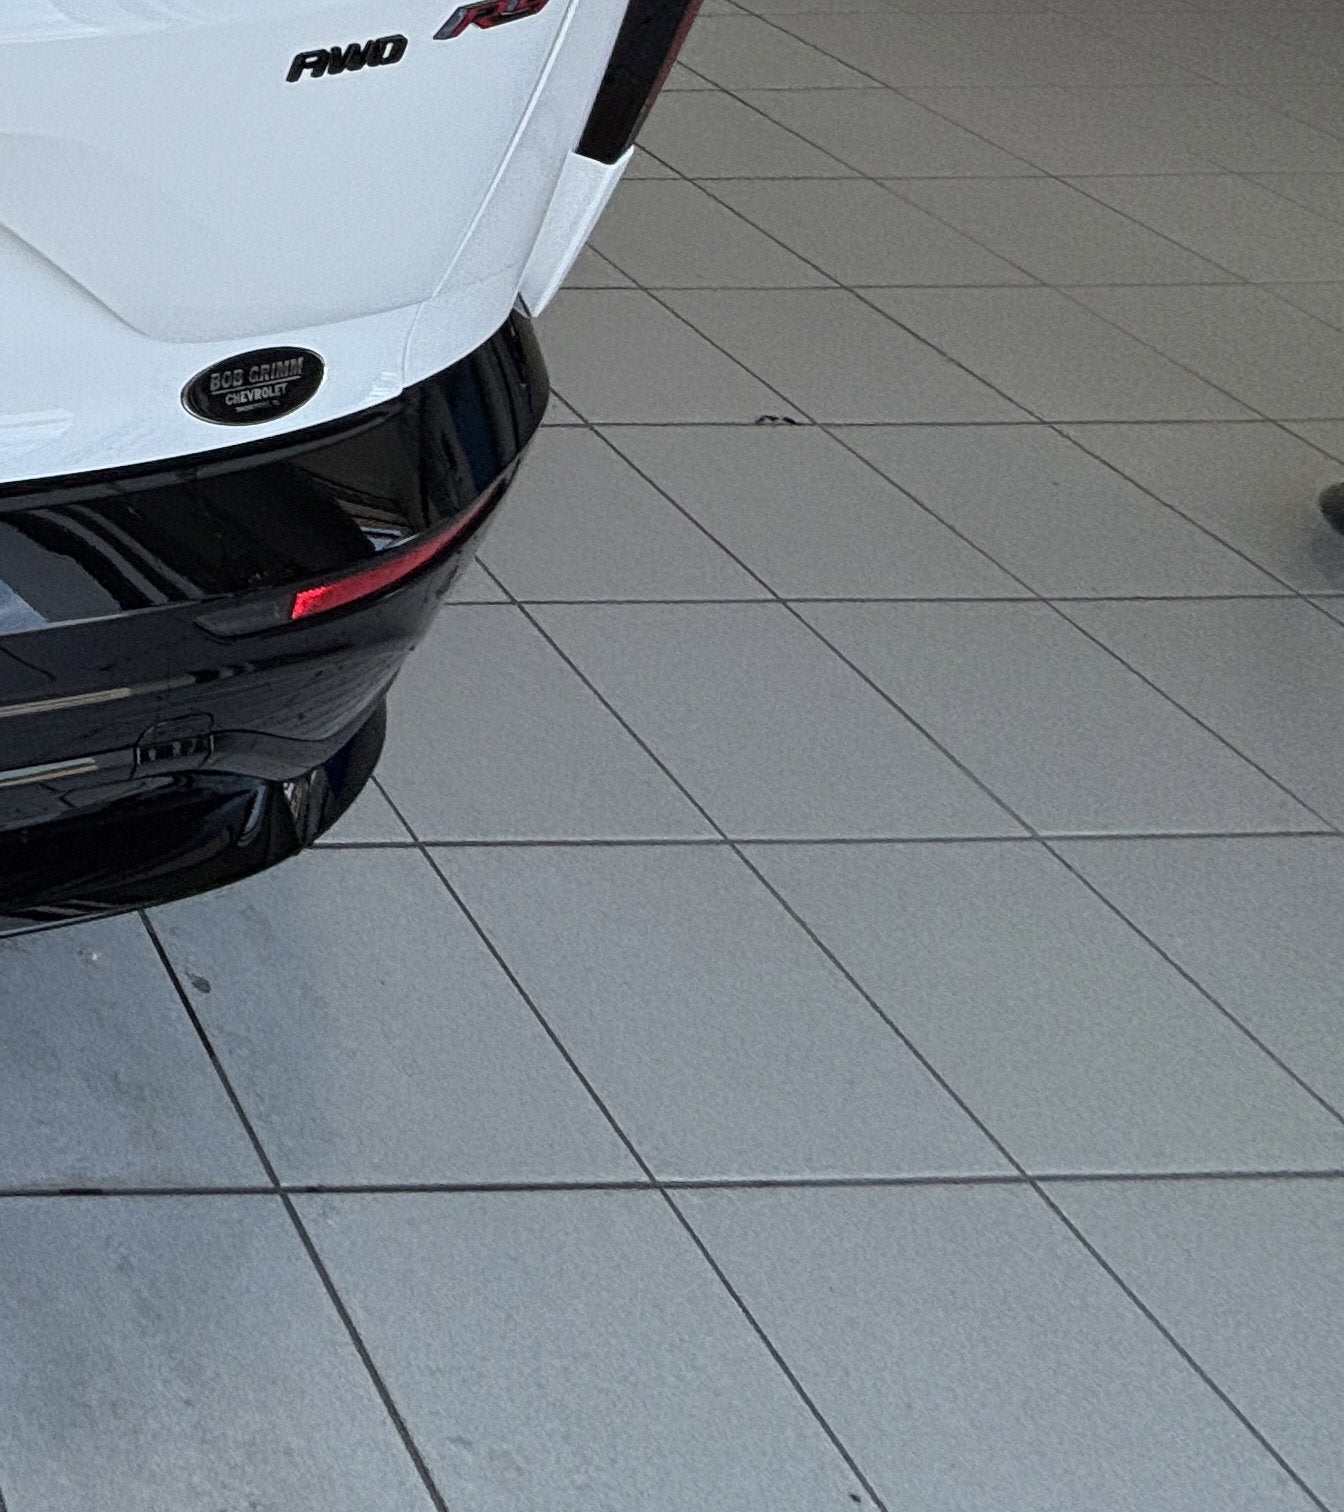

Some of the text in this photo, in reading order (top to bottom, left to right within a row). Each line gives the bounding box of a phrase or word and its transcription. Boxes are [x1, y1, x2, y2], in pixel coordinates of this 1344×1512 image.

[286, 34, 409, 83] AWD
[210, 357, 305, 391] BOB GRIMM
[224, 383, 289, 406] CHEVROLET
